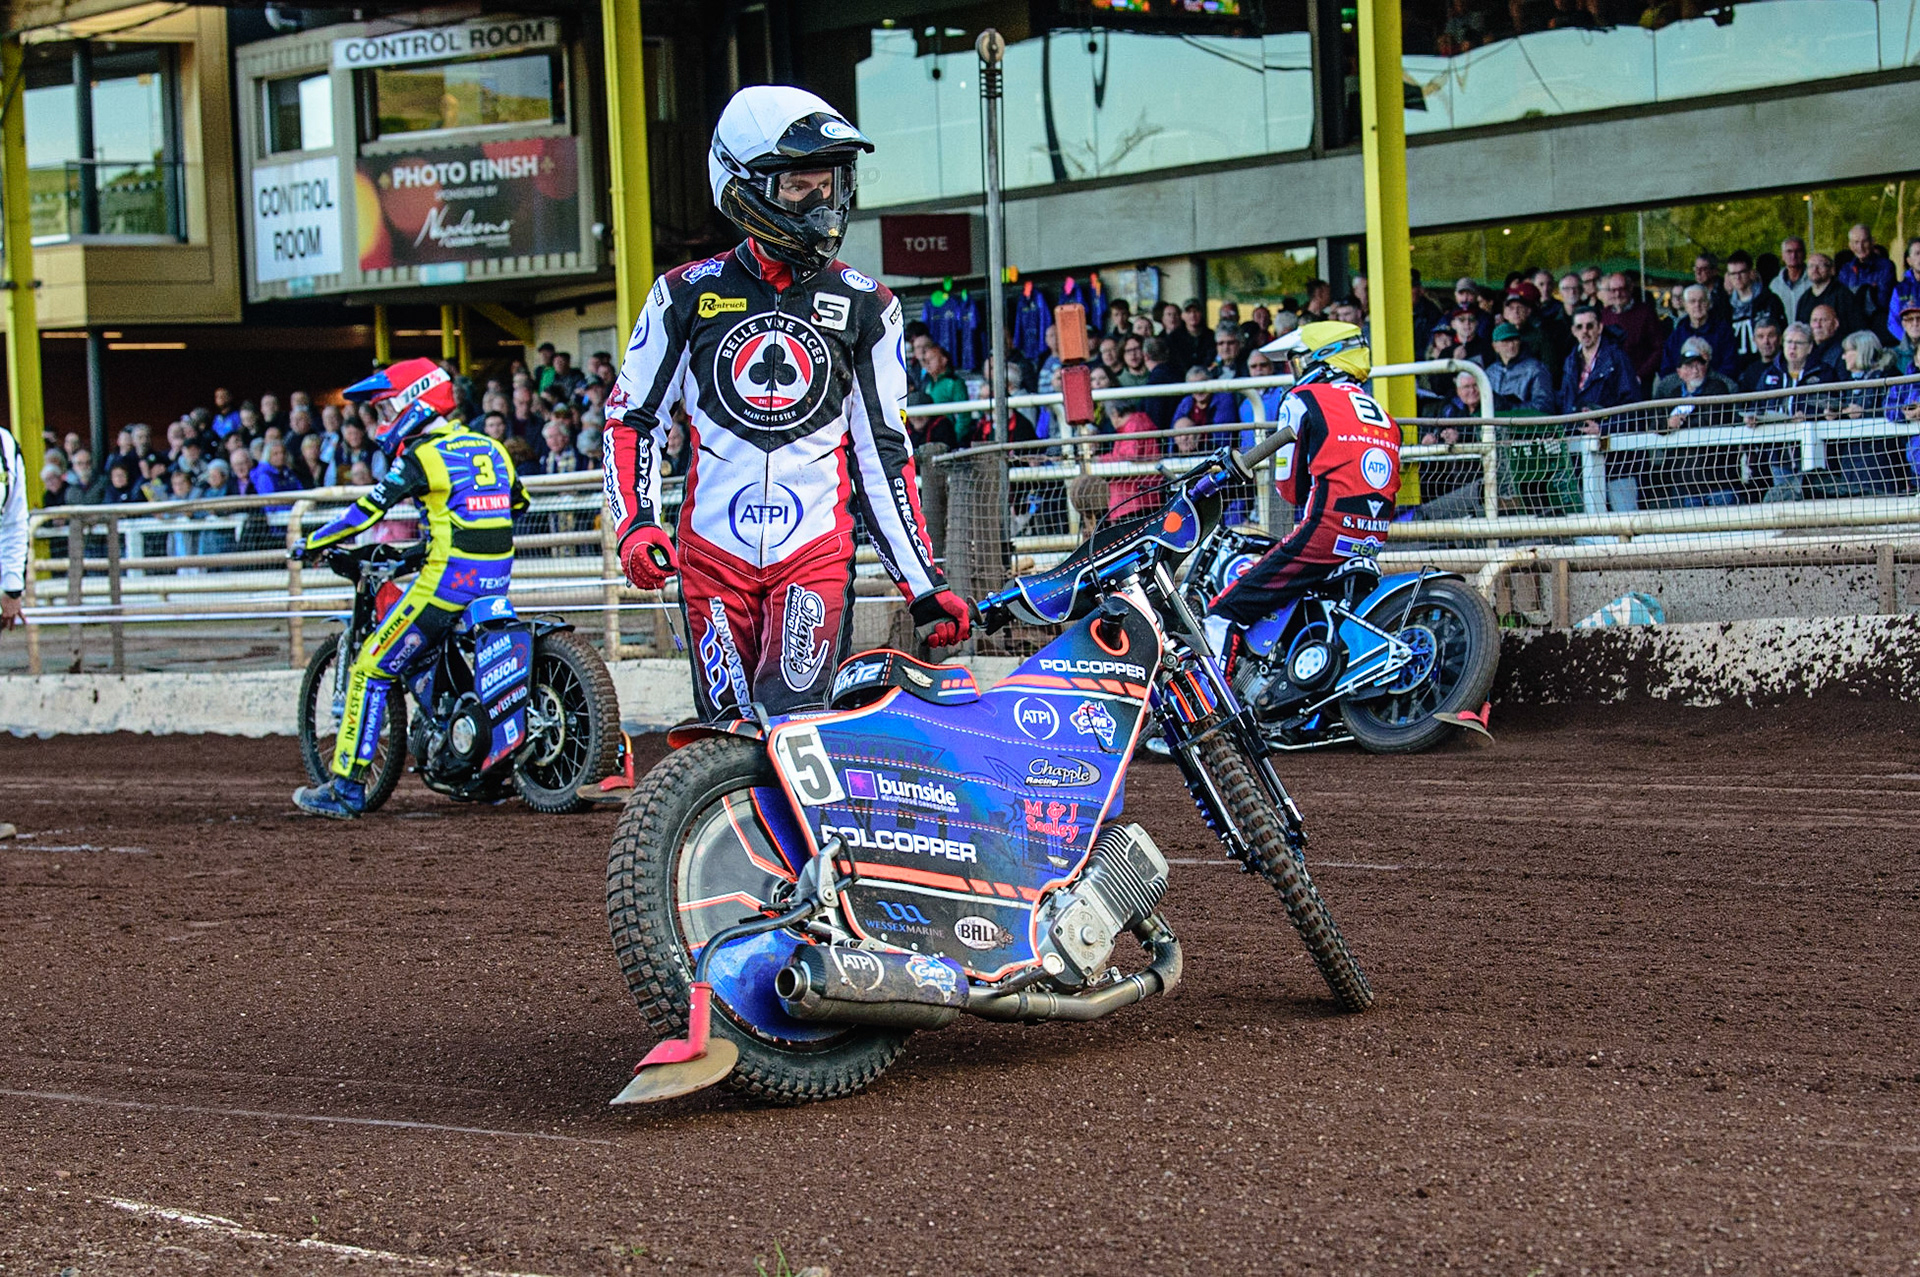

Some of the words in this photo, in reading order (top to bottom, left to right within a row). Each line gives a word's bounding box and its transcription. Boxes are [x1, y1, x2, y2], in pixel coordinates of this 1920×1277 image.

[345, 32, 462, 62] CONTROL
[469, 23, 546, 48] ROOM
[392, 161, 467, 189] PHOTO
[469, 155, 539, 183] FINISH
[259, 178, 333, 217] CONTROL
[274, 226, 323, 261] ROOM
[903, 236, 948, 252] TOTE
[848, 272, 871, 287] ATPI
[701, 298, 745, 311] Rentruck
[813, 300, 845, 323] 5
[722, 322, 759, 360] BELLE
[800, 331, 825, 365] ACES
[743, 408, 798, 422] MANCHESTER
[1337, 434, 1399, 453] MANCHESTE
[472, 453, 497, 486] 3
[1367, 461, 1386, 475] ATPI
[739, 504, 789, 525] ATPI
[787, 585, 804, 630] Racing
[1039, 659, 1147, 681] POLCOPPER
[1022, 709, 1052, 725] ATPI
[1077, 715, 1108, 729] GM
[785, 734, 832, 800] 5
[1028, 757, 1090, 784] Chapple
[876, 773, 957, 806] burnside
[1026, 776, 1059, 787] Racing
[1023, 799, 1044, 817] M
[1047, 801, 1067, 819] &
[1067, 803, 1079, 824] J
[1026, 815, 1080, 844] Sealey
[820, 824, 978, 864] POLCOPPER
[864, 918, 945, 938] WESSEXMARINE
[961, 923, 996, 942] BALL
[843, 953, 876, 972] ATPI
[914, 965, 948, 979] GM
